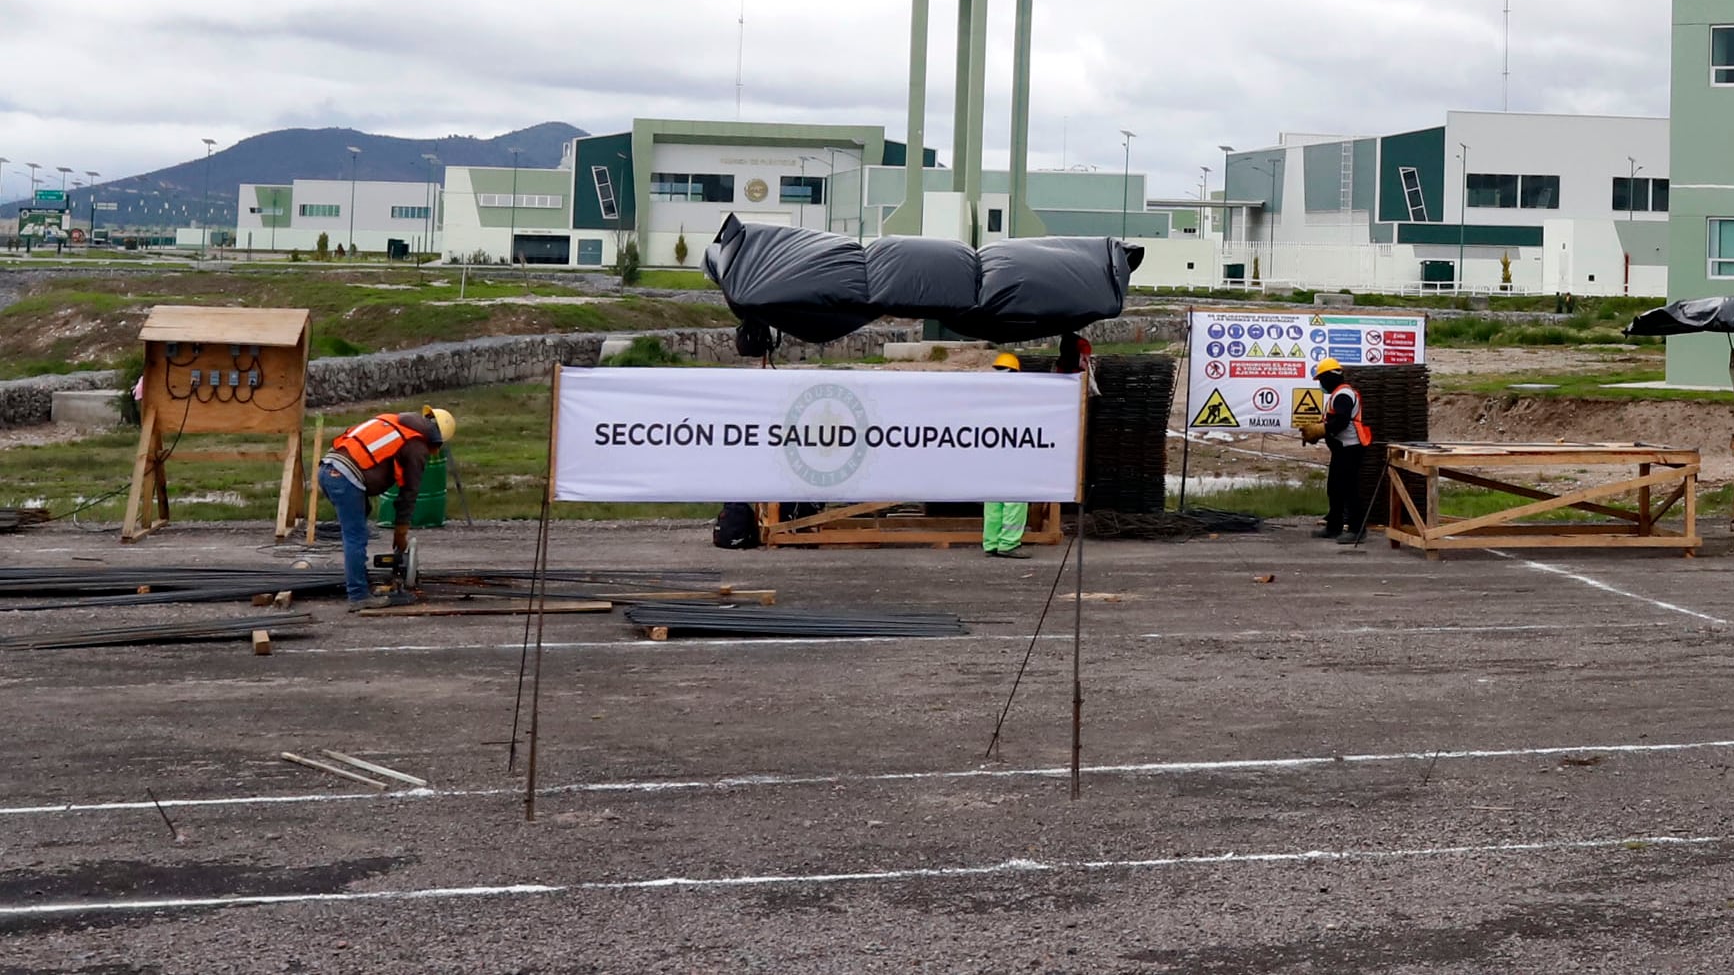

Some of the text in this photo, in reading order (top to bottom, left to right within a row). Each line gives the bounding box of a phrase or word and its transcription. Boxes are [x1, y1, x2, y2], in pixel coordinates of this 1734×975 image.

[1259, 391, 1274, 404] 10
[1249, 417, 1281, 427] MÁXIMA
[594, 417, 1056, 449] SECCIÓN DE SALUD OCUPACIONAL.
